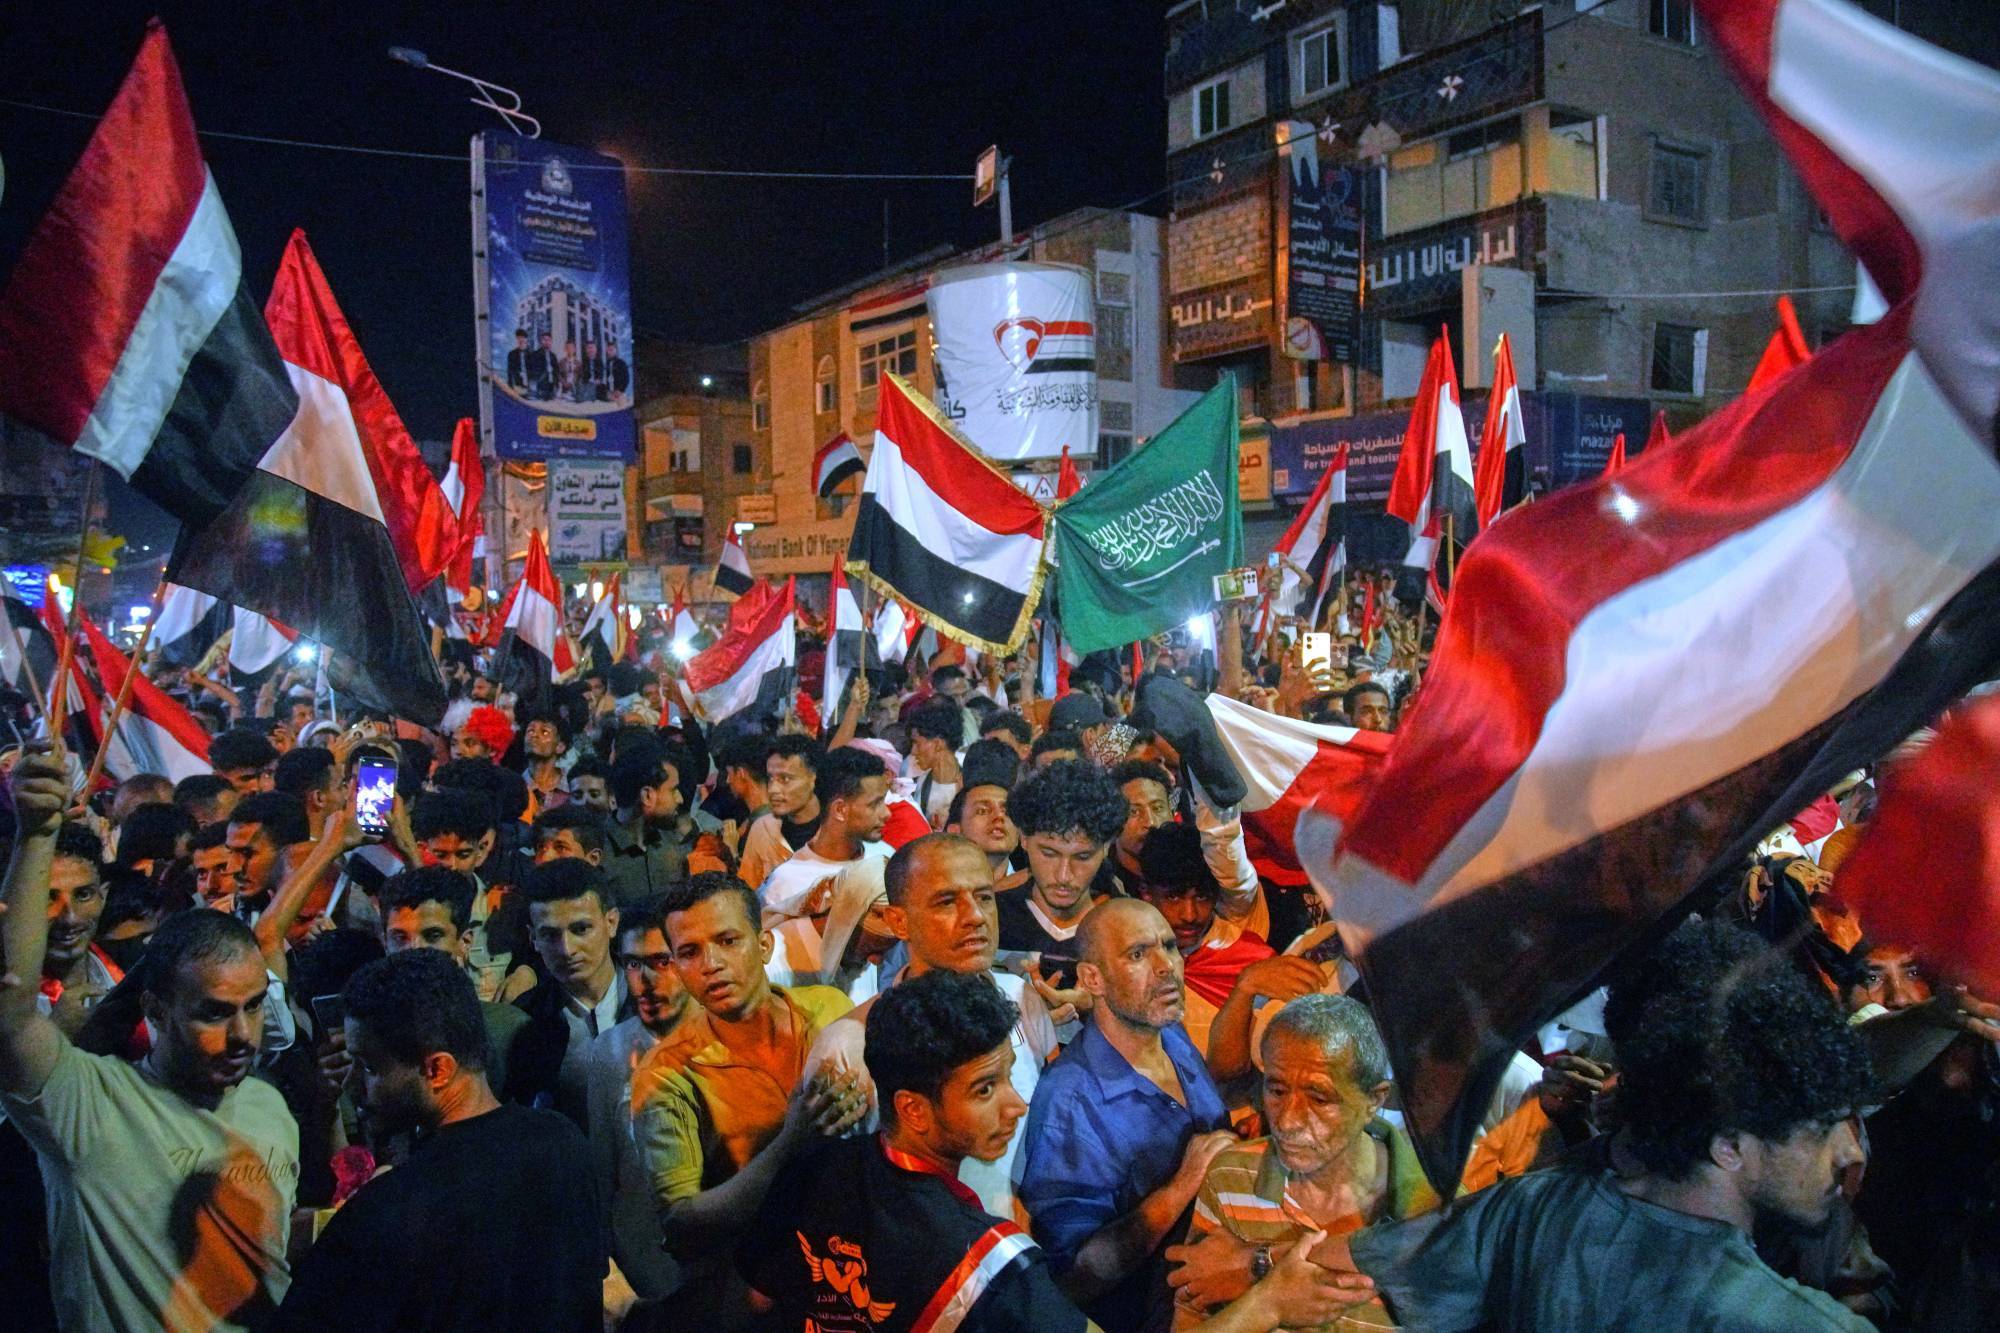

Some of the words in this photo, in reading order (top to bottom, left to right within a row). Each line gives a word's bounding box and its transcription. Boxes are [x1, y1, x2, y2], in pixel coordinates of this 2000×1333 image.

[1303, 439, 1351, 457] ولسياحة
[1348, 454, 1366, 467] and
[1367, 452, 1400, 465] touris
[782, 536, 803, 558] Bank
[806, 533, 818, 556] Of
